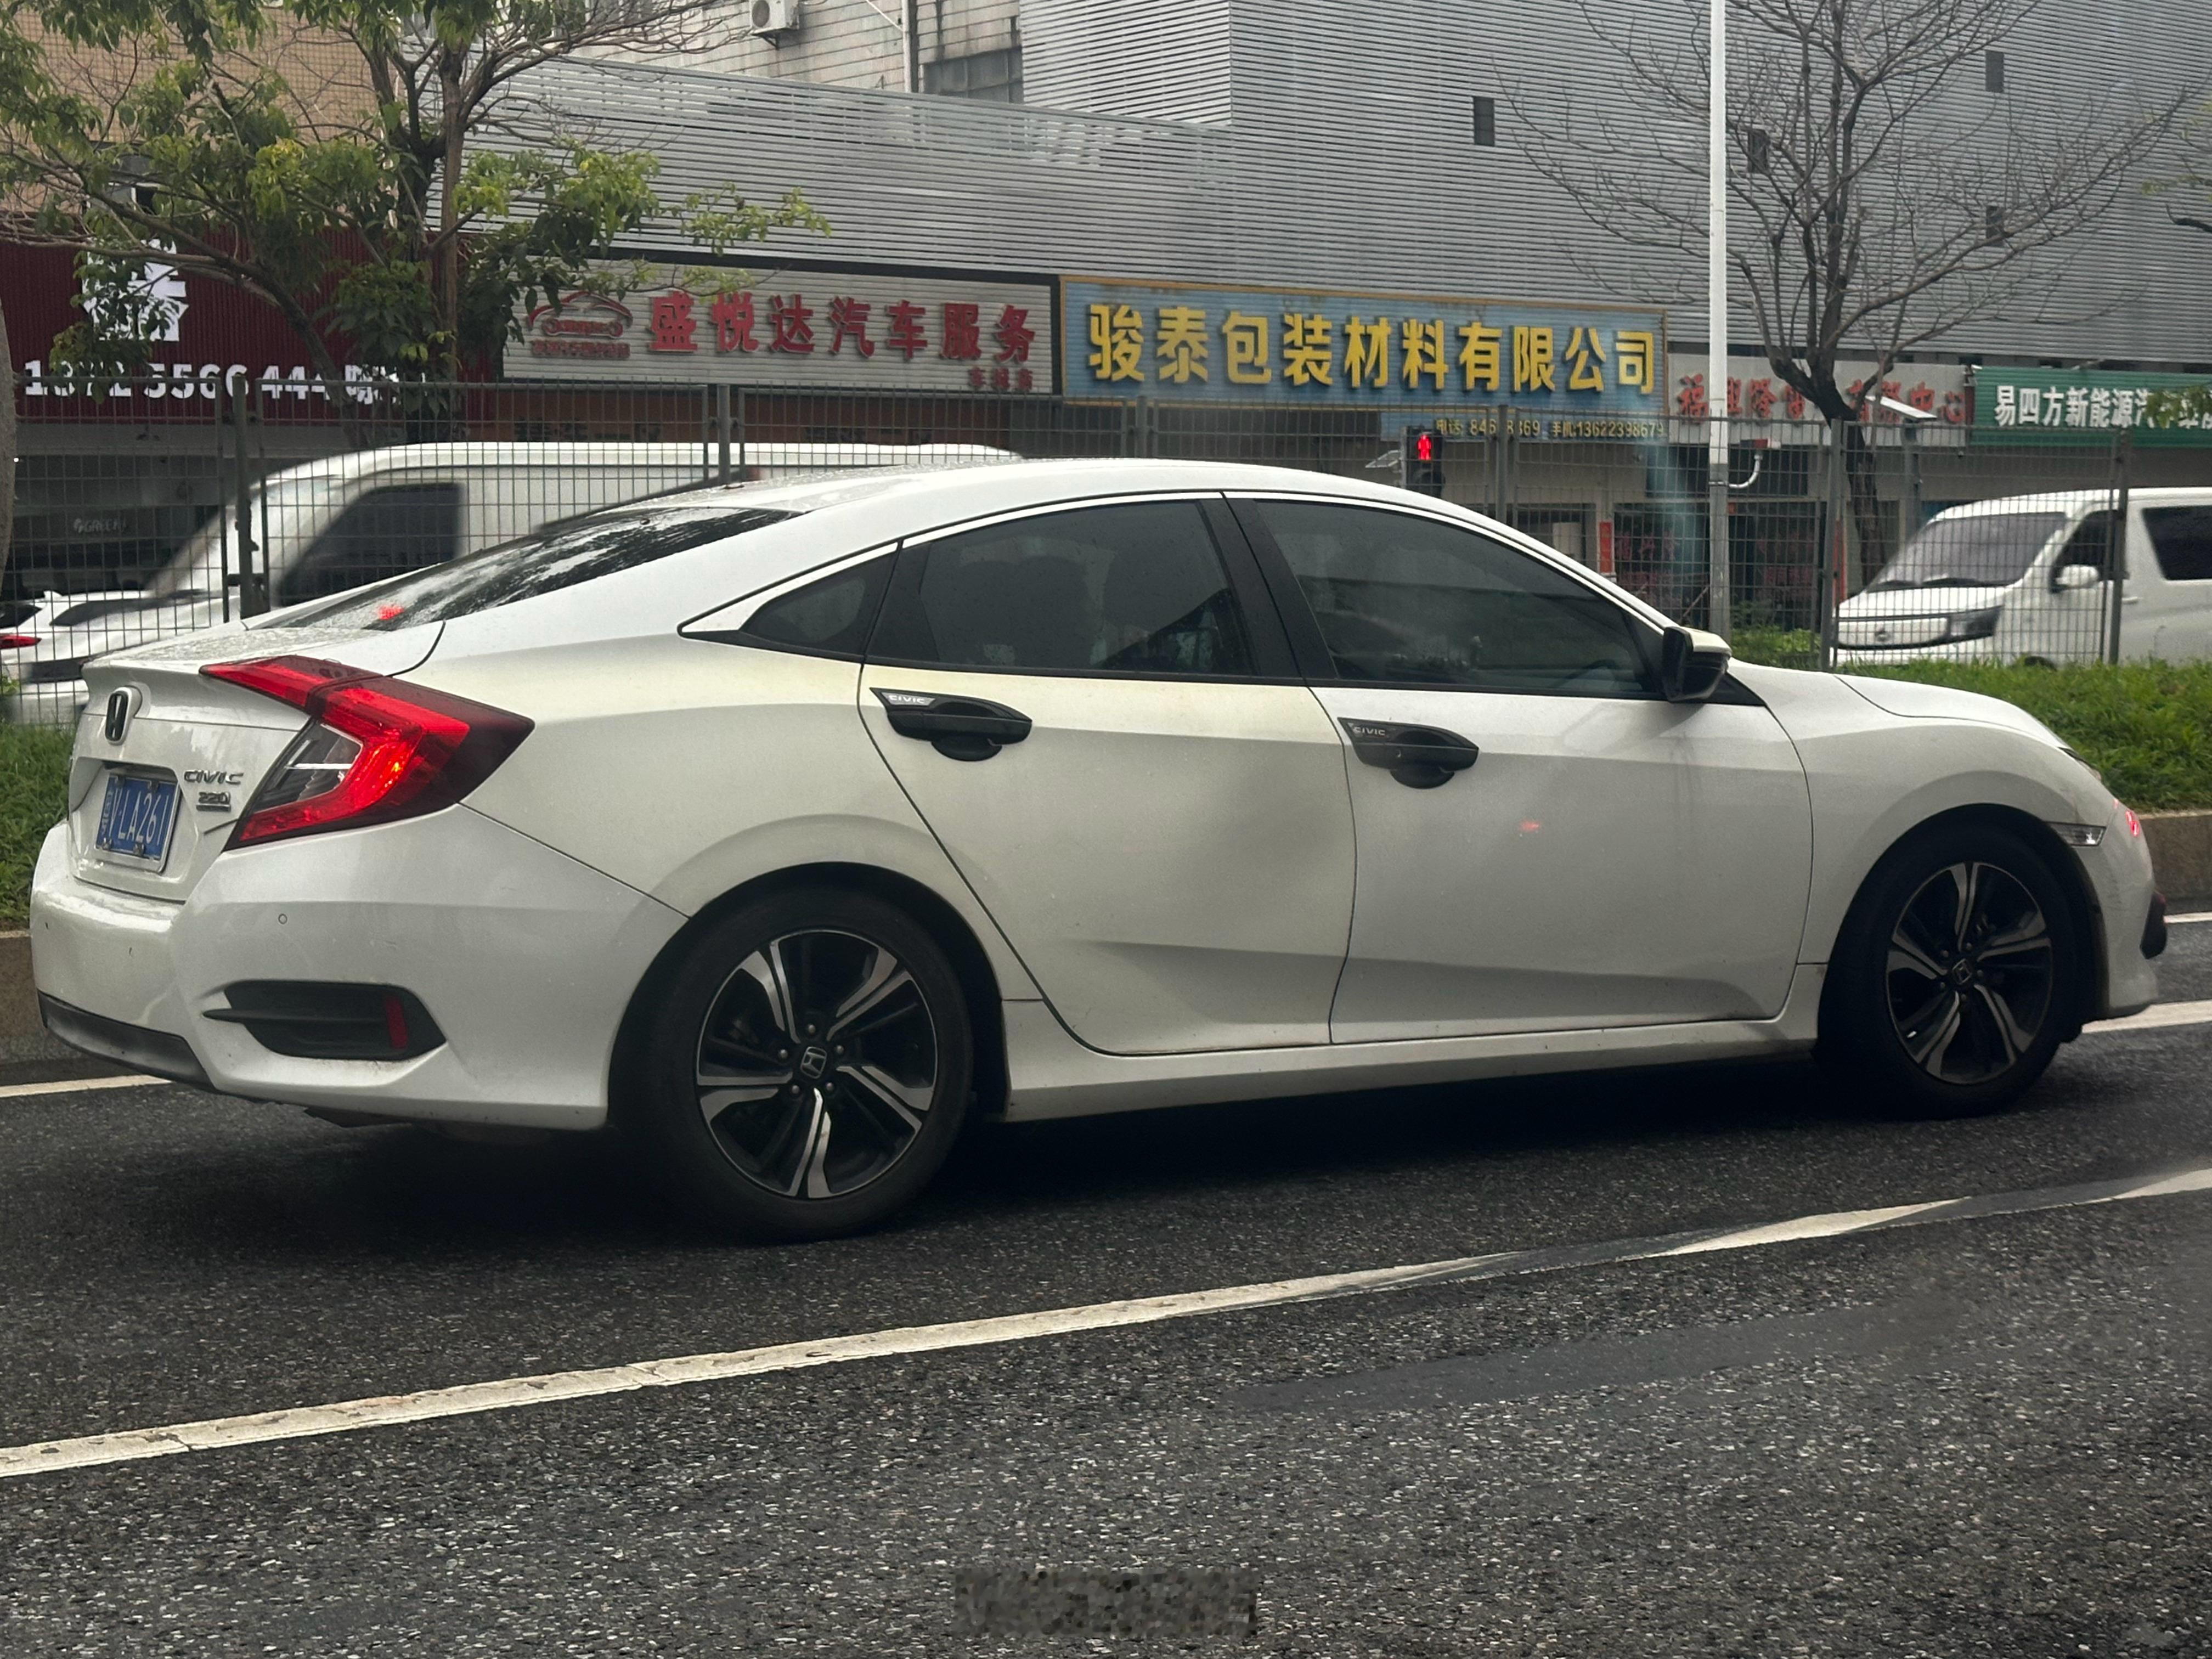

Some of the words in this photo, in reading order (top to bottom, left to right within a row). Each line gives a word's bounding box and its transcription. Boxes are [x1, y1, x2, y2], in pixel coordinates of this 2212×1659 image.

[649, 291, 1035, 363] 盛悦达汽车服务
[1090, 304, 1654, 394] 骏泰包装材料有限公司
[888, 695, 925, 704] CIVIC
[1353, 726, 1386, 736] CIVIC
[184, 770, 244, 785] CIVIC
